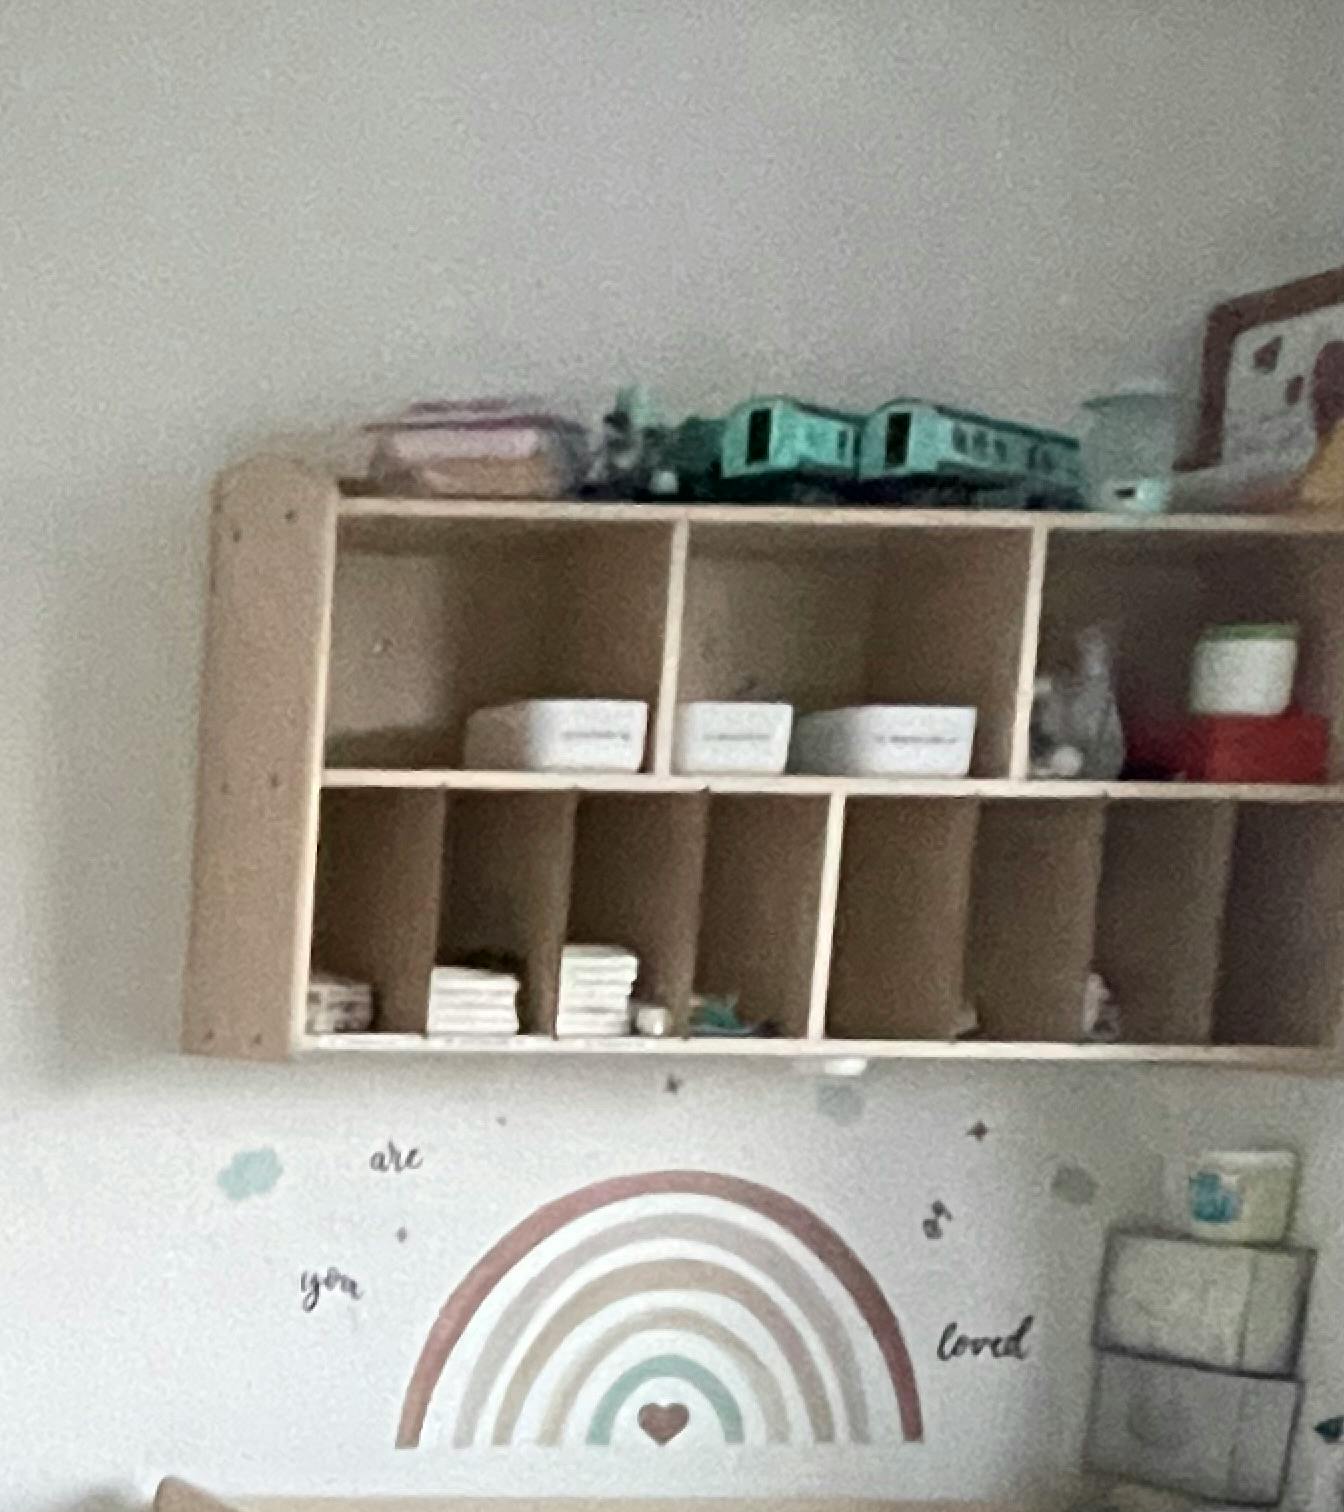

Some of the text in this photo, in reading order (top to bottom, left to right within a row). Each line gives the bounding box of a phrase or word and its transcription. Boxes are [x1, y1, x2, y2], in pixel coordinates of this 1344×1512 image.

[369, 1139, 424, 1172] are
[299, 1266, 362, 1311] you
[936, 1315, 1034, 1360] loved
